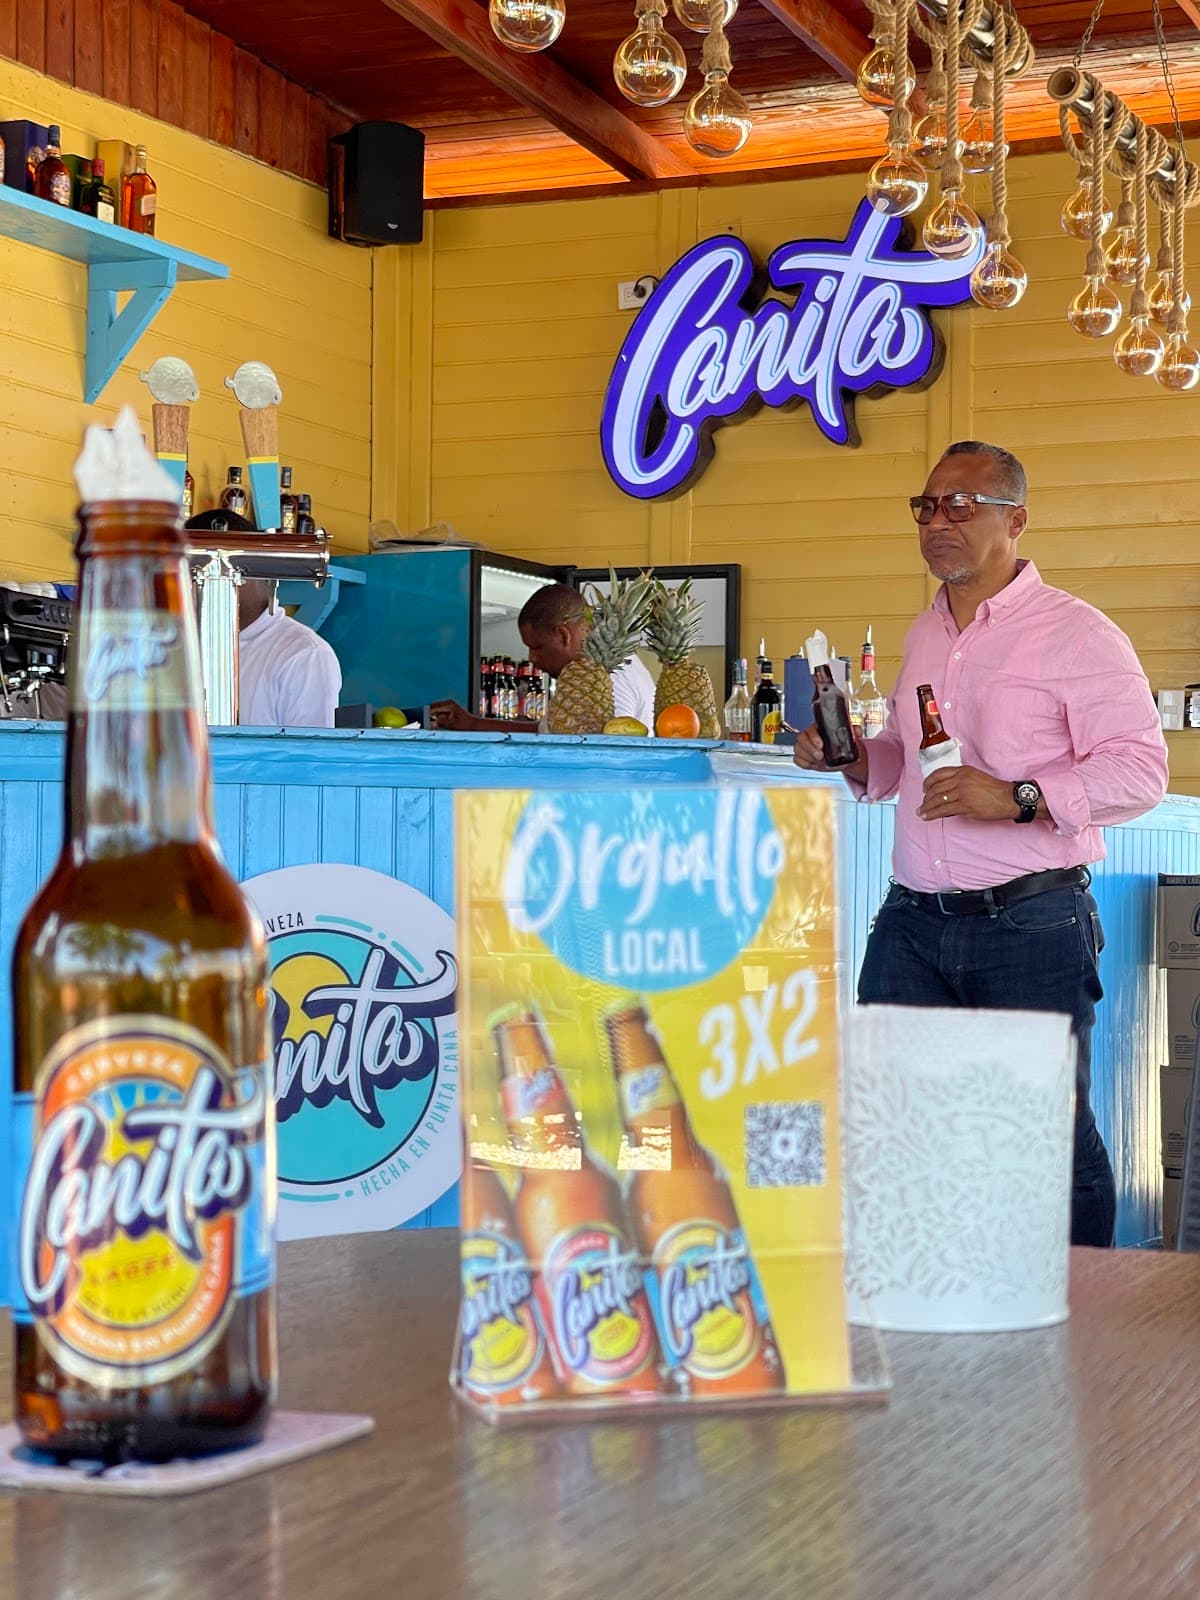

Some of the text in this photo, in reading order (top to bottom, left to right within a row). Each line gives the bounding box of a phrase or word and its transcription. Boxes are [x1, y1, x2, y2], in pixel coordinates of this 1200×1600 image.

[612, 197, 985, 485] Canita
[265, 912, 304, 936] VEZA
[603, 929, 706, 977] LOCAL
[268, 949, 457, 1114] nita
[360, 1029, 458, 1197] HECHA EN PUNTA CANA
[698, 967, 820, 1100] 3X2
[19, 1066, 266, 1302] Canita
